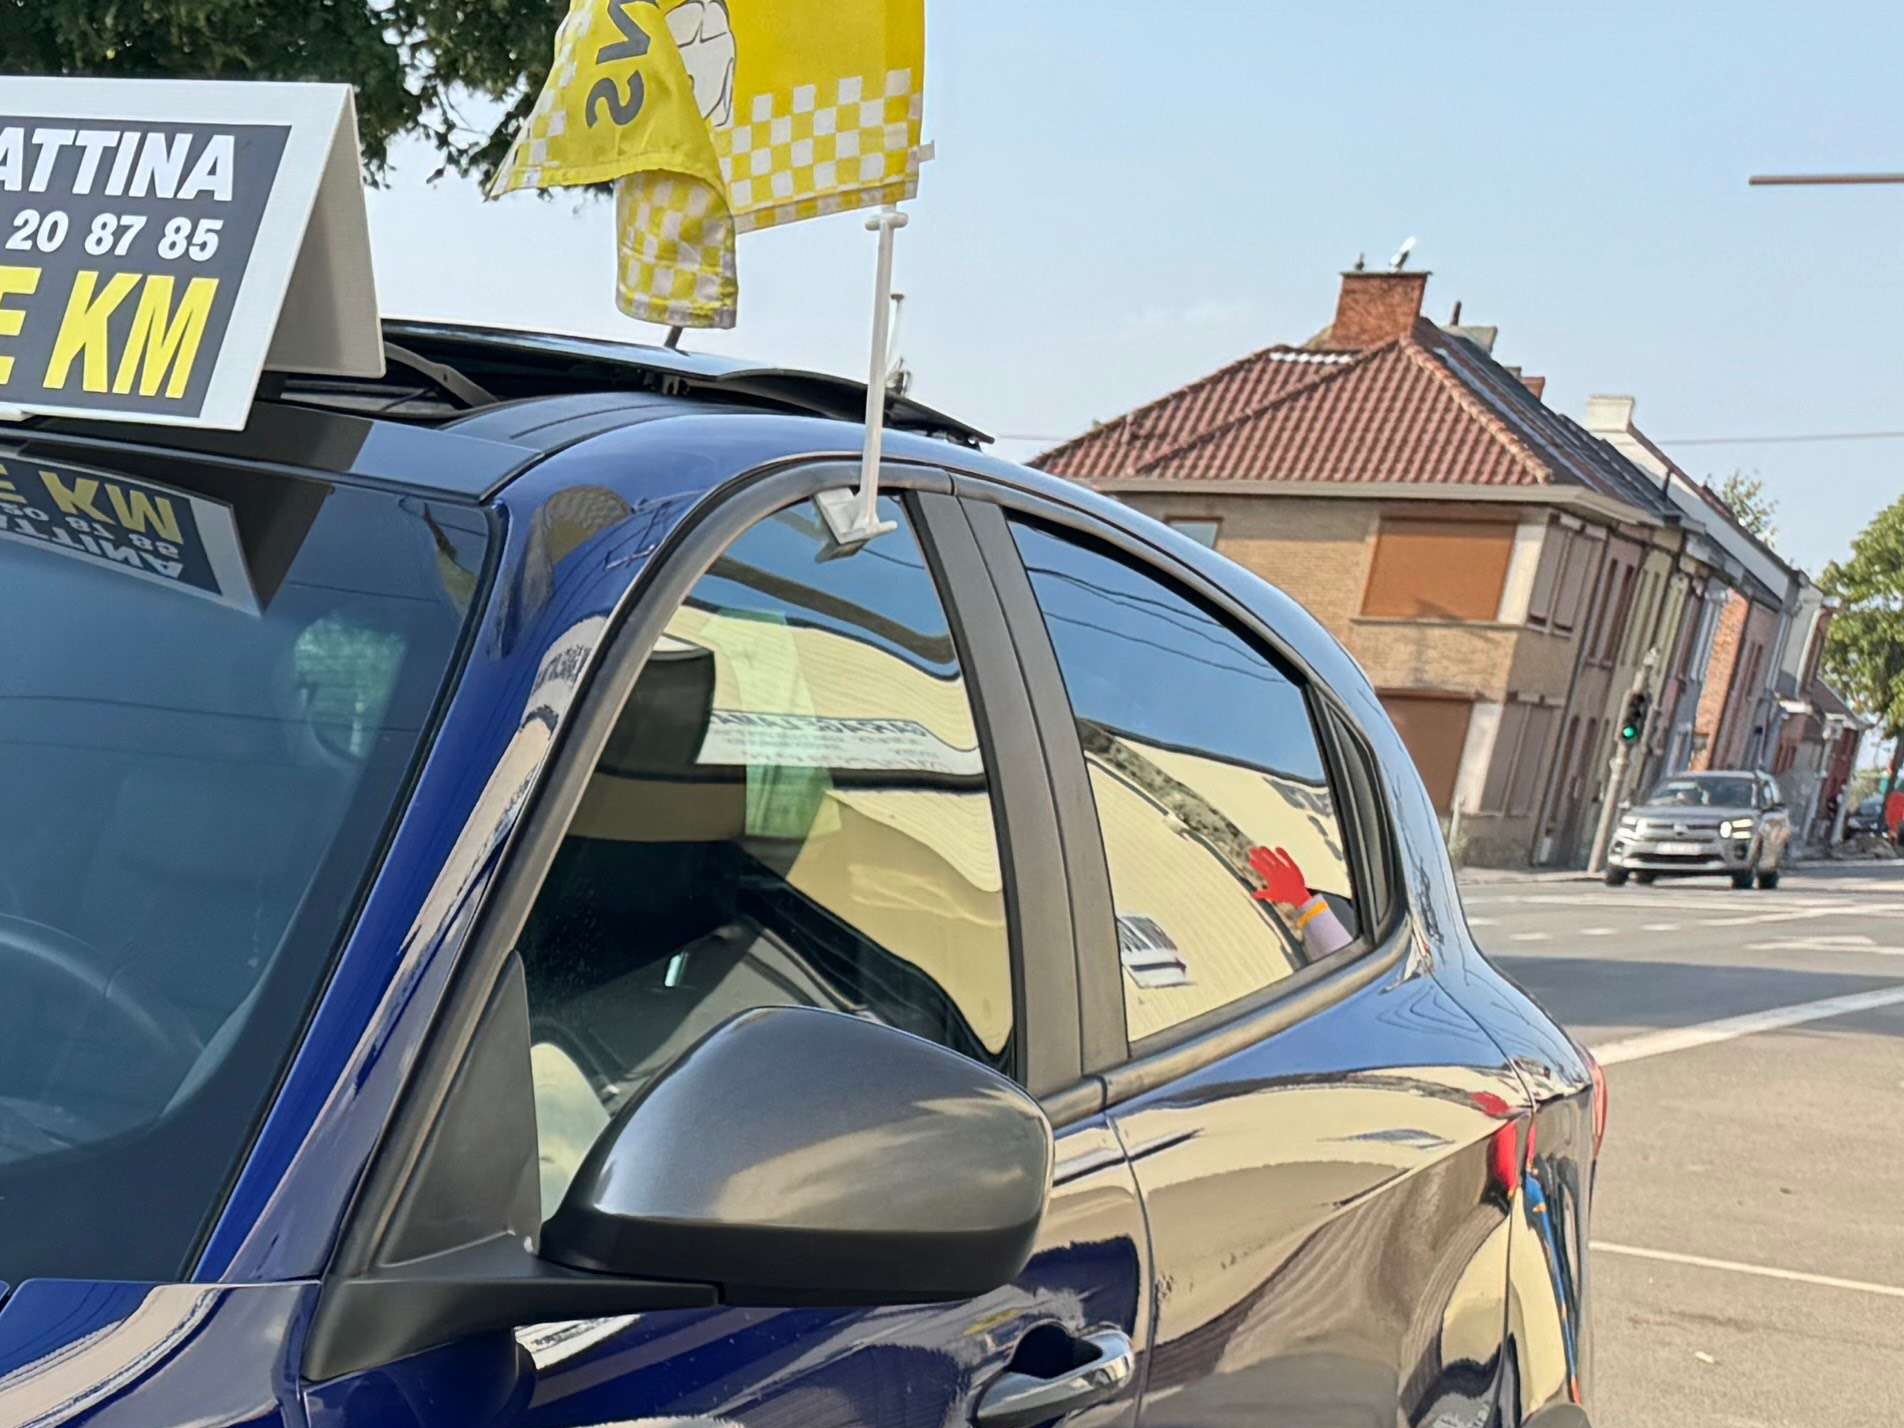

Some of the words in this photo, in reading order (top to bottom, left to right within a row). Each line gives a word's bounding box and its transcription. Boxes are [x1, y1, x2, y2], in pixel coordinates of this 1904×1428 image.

[4, 208, 70, 253] 20
[83, 211, 148, 257] 87
[157, 216, 225, 262] 85
[42, 270, 220, 399] KM
